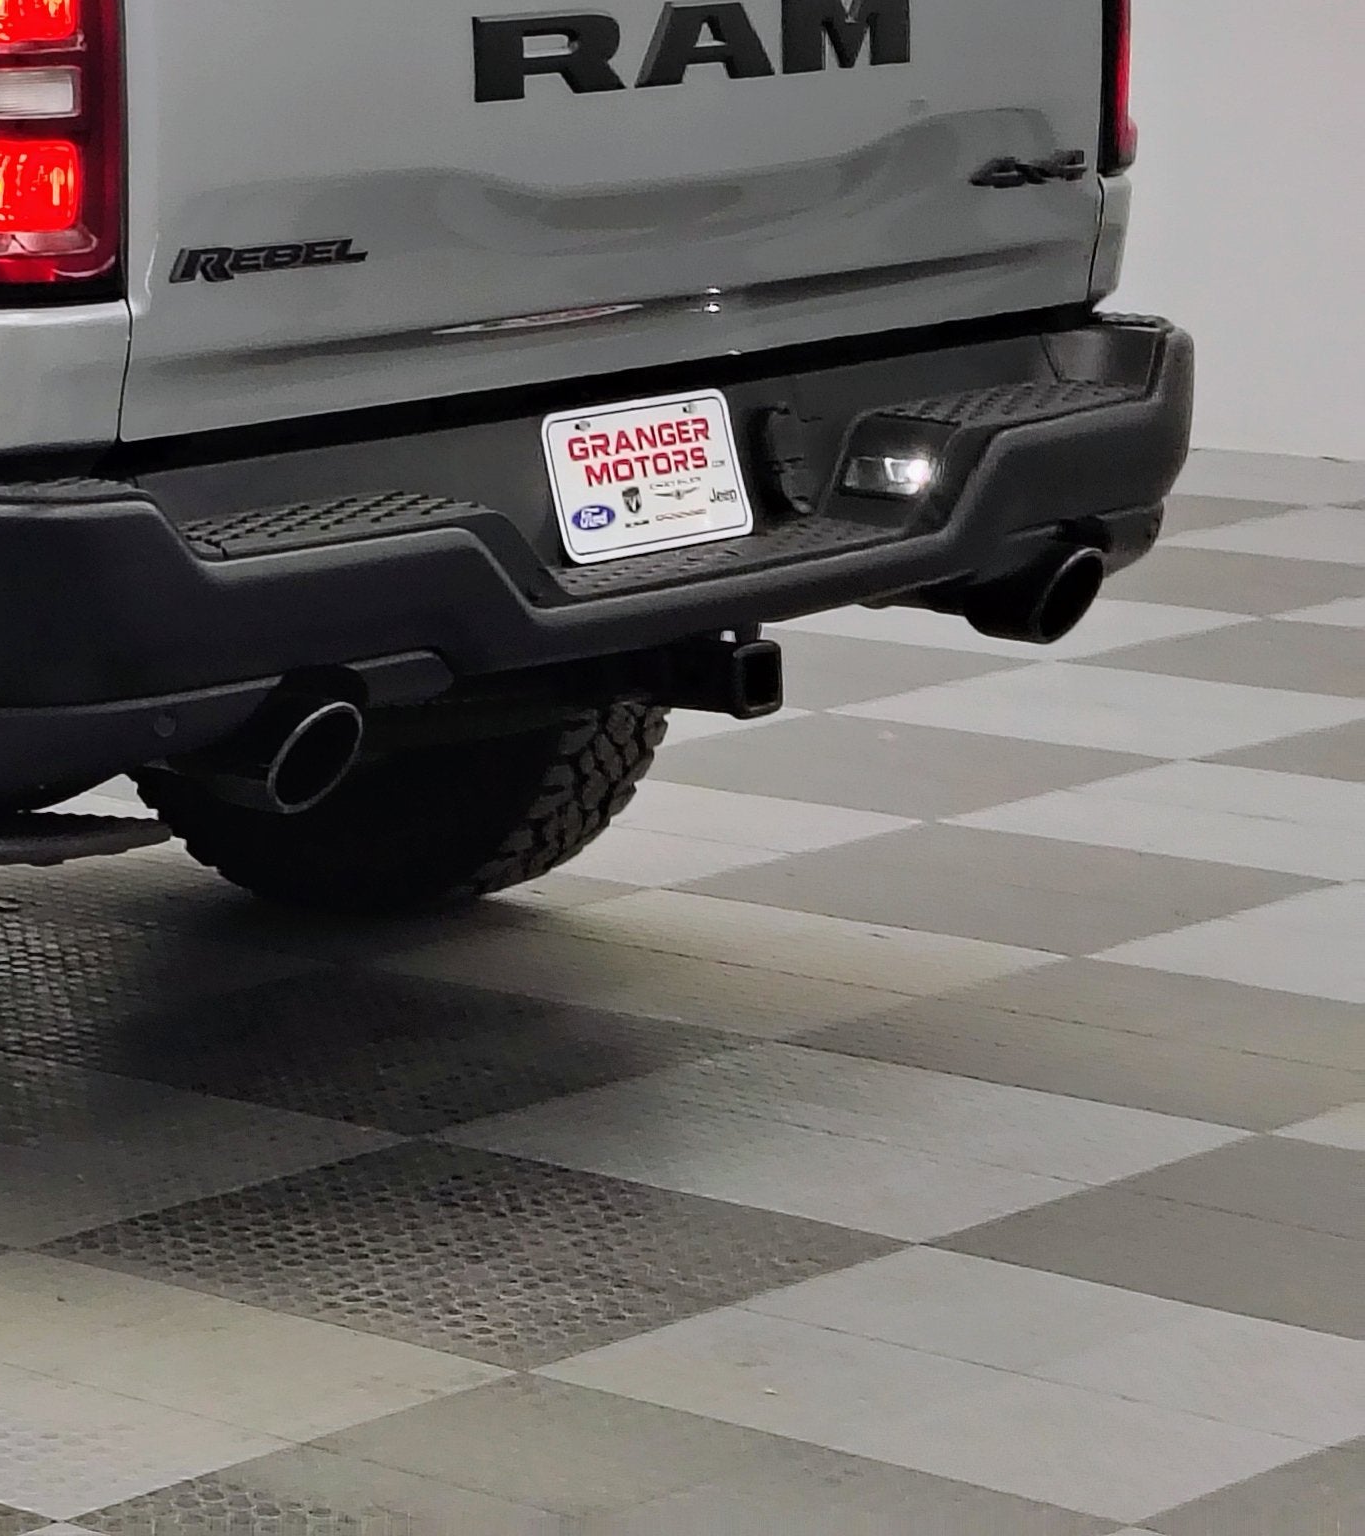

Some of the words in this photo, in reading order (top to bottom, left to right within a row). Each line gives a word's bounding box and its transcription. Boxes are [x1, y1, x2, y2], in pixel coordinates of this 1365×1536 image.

[169, 238, 369, 284] REBEL
[567, 417, 710, 462] GRANGER
[584, 447, 708, 488] MOTORS
